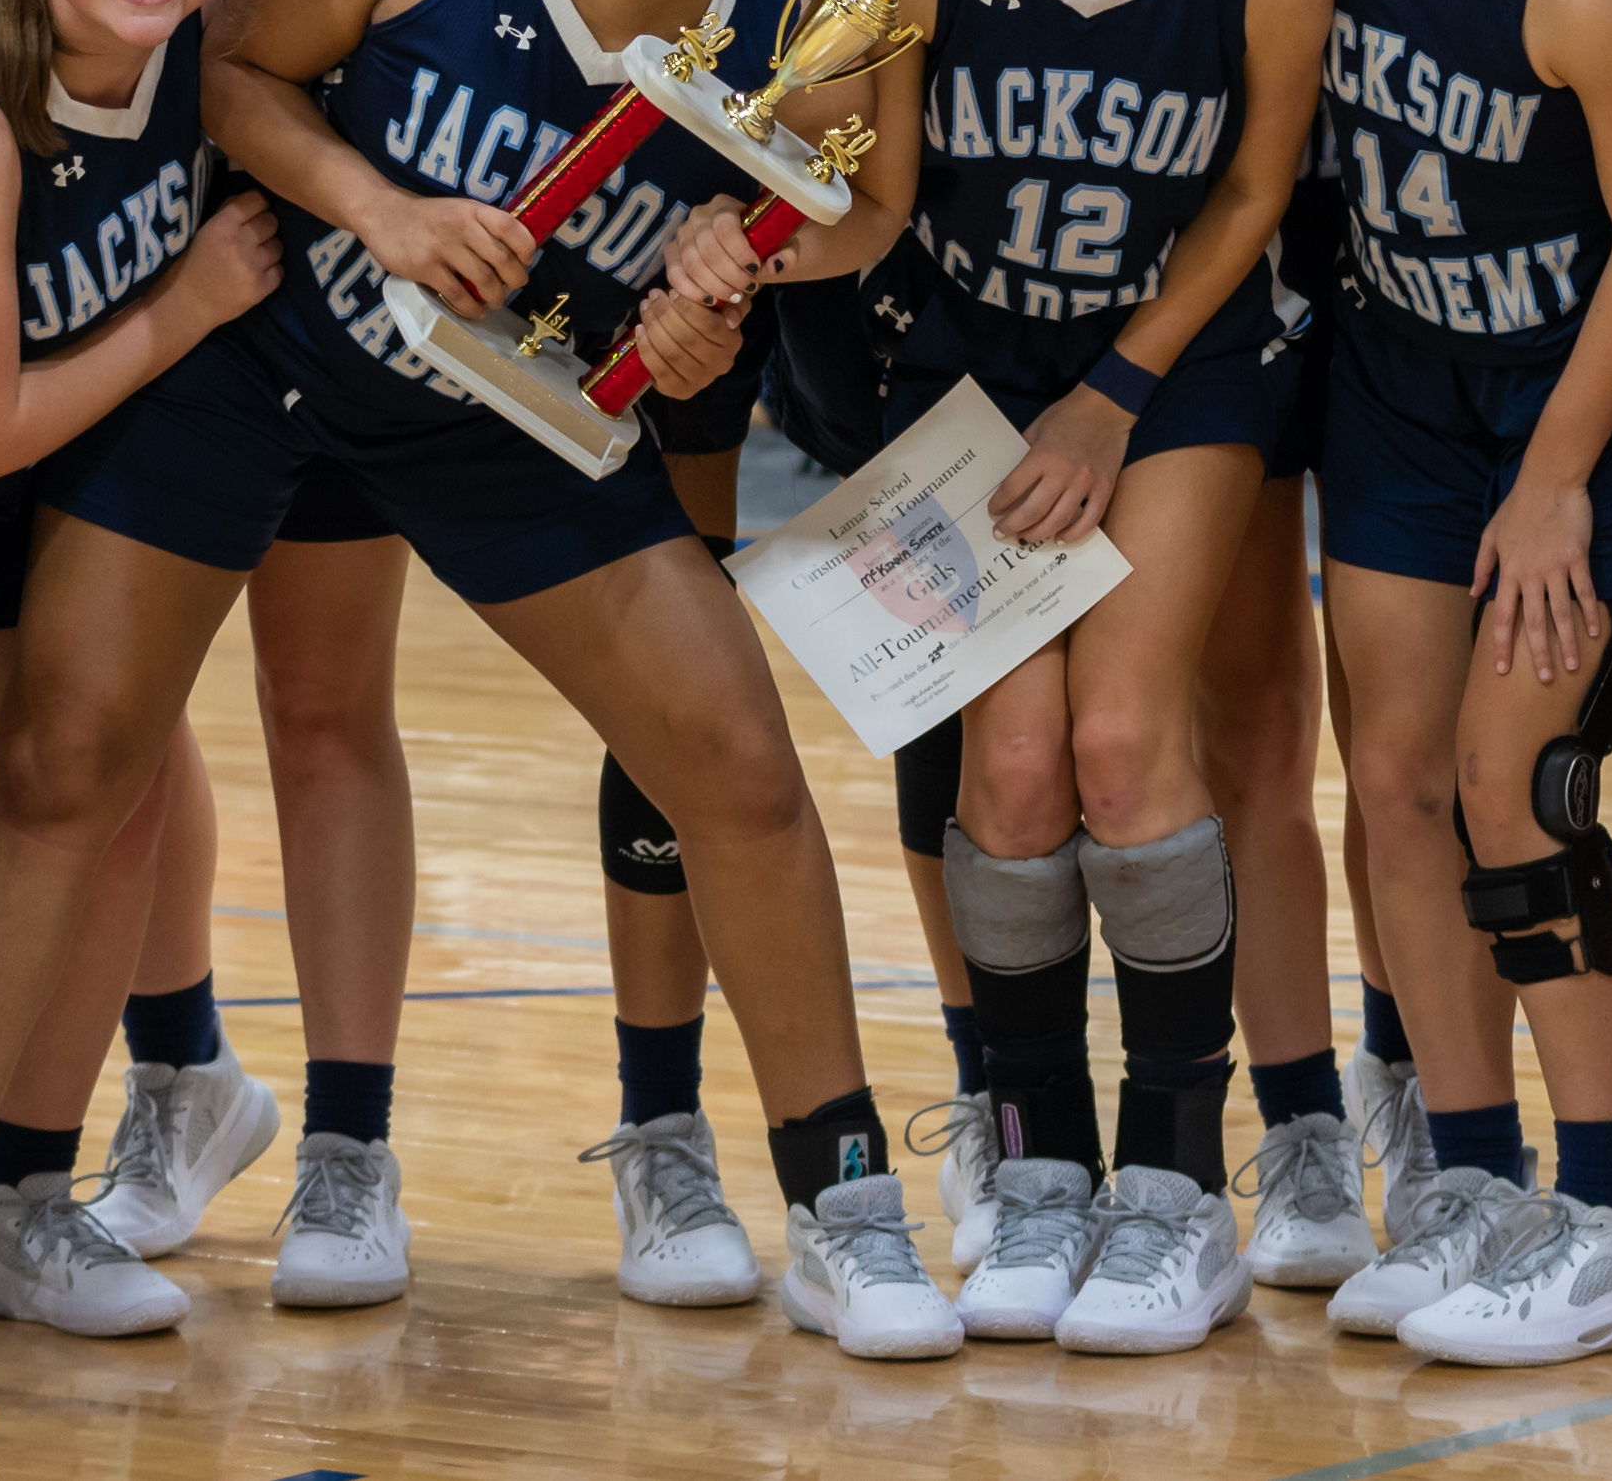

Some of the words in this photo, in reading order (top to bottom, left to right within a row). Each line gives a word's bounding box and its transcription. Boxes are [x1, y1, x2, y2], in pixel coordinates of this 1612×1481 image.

[1322, 8, 1541, 163] CKSON
[997, 178, 1131, 276] 12
[1353, 127, 1467, 237] 14
[23, 144, 210, 341] JACKSO
[1349, 206, 1579, 334] CADEMY
[791, 544, 859, 591] Christmas
[857, 517, 895, 548] Bash
[891, 448, 977, 519] Tournament
[828, 507, 870, 541] Lamar
[869, 472, 912, 511] School
[893, 515, 934, 550] recognizes
[939, 533, 953, 548] the
[849, 568, 1000, 684] All-Tournament
[906, 562, 957, 602] Girls
[917, 661, 929, 673] the
[968, 603, 1005, 634] December
[1012, 588, 1025, 601] the
[1025, 576, 1040, 592] year
